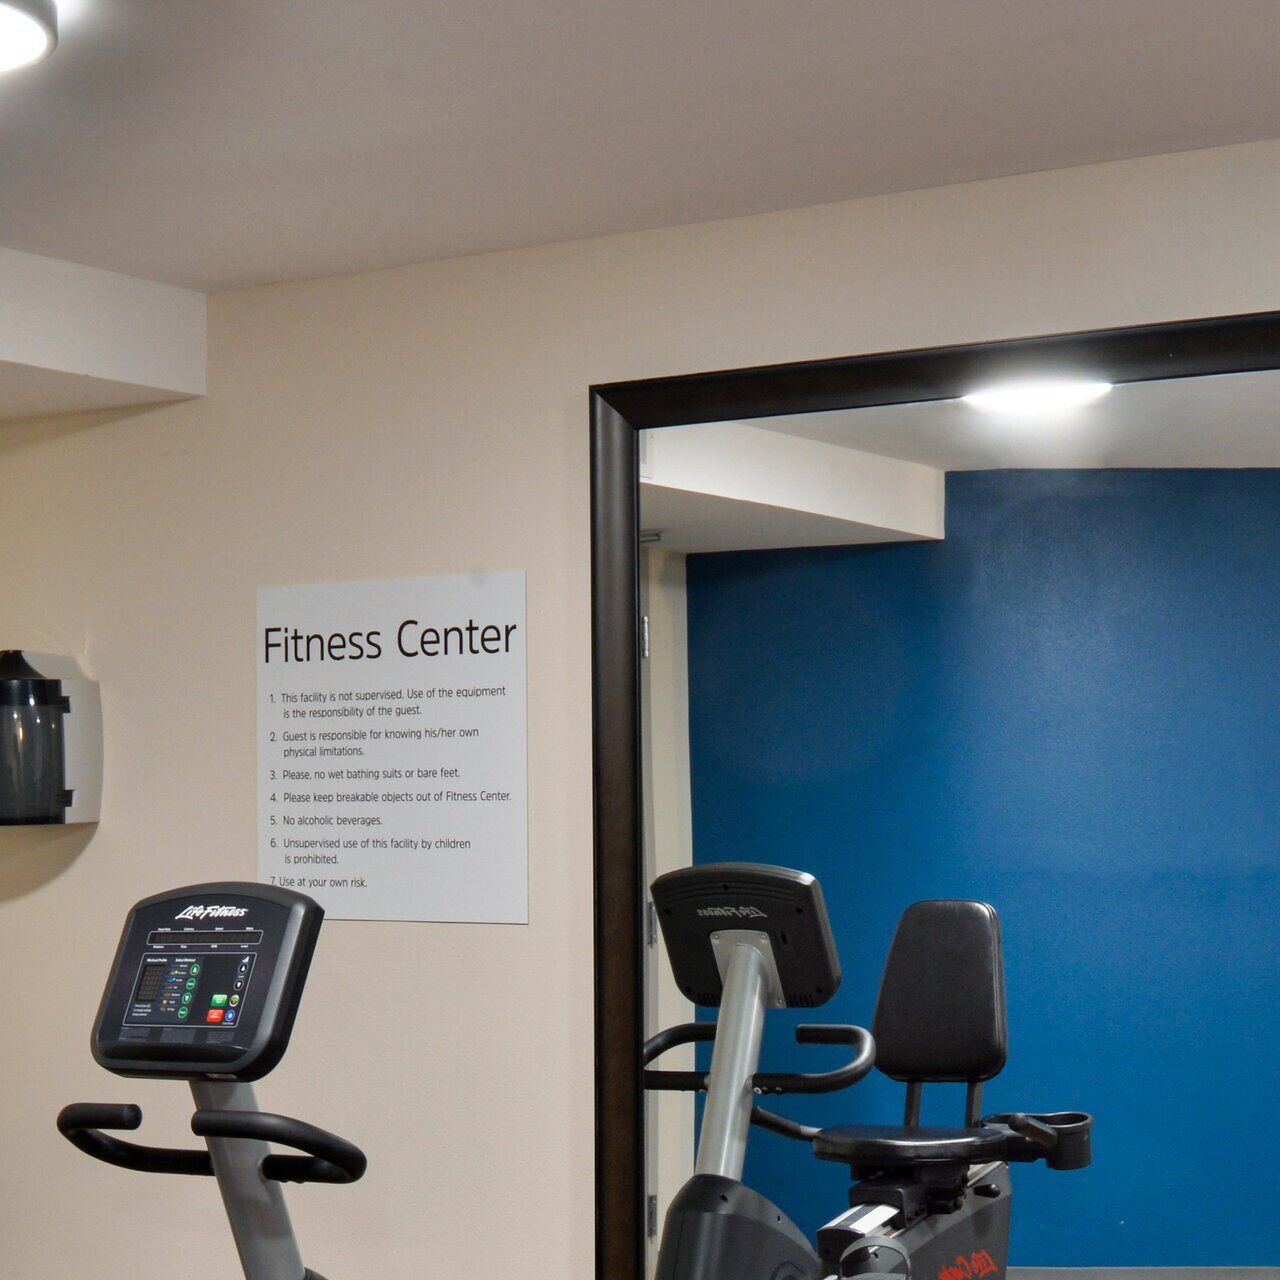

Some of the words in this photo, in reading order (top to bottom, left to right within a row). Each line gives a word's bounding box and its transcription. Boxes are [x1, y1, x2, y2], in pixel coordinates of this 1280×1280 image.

[264, 626, 383, 664] Fitness
[396, 619, 517, 658] Center
[281, 692, 298, 703] This
[300, 691, 327, 704] facility
[329, 691, 336, 702] is
[338, 691, 353, 702] not
[407, 688, 424, 699] Use
[426, 687, 437, 699] of
[438, 687, 454, 699] the
[455, 686, 507, 699] equipment
[283, 708, 290, 719] is
[292, 708, 307, 719] the
[308, 706, 364, 720] responsibility
[366, 705, 376, 717] of
[378, 705, 393, 717] the
[395, 705, 422, 718] guest.
[282, 731, 308, 742] Guest
[309, 731, 317, 741] is
[318, 729, 367, 743] responsible
[369, 729, 382, 740] for
[384, 728, 422, 741] knowing
[424, 727, 456, 739] his/her
[458, 728, 479, 738] own
[283, 746, 317, 759] physical
[319, 745, 365, 757] limitations.
[282, 769, 312, 781] Please,
[314, 770, 326, 780] no
[327, 770, 344, 780] wet
[346, 768, 380, 781] bathing
[382, 767, 403, 779] suits
[404, 769, 414, 779] or
[416, 767, 438, 779] bare
[440, 767, 461, 779] feet.
[283, 792, 311, 803] Please
[313, 792, 334, 804] keep
[336, 792, 379, 803] breakable
[381, 791, 414, 804] objects
[415, 792, 431, 803] out
[433, 790, 444, 802] of
[446, 790, 478, 802] Fitness
[480, 790, 512, 802] Center.
[269, 815, 278, 826] 5.
[282, 815, 296, 826] No
[297, 815, 334, 826] alcoholic
[336, 815, 383, 827] beverages.
[283, 837, 341, 849] Unsupervised
[342, 839, 358, 849] use
[360, 837, 370, 849] of
[372, 837, 388, 849] this
[390, 837, 419, 850] facility
[421, 838, 433, 850] by
[434, 837, 471, 849] children
[284, 853, 291, 864] is
[293, 853, 340, 865] prohibited.
[279, 876, 295, 887] Use
[297, 877, 306, 887] at
[308, 878, 327, 889] your
[329, 878, 349, 888] own
[350, 877, 368, 888] risk.
